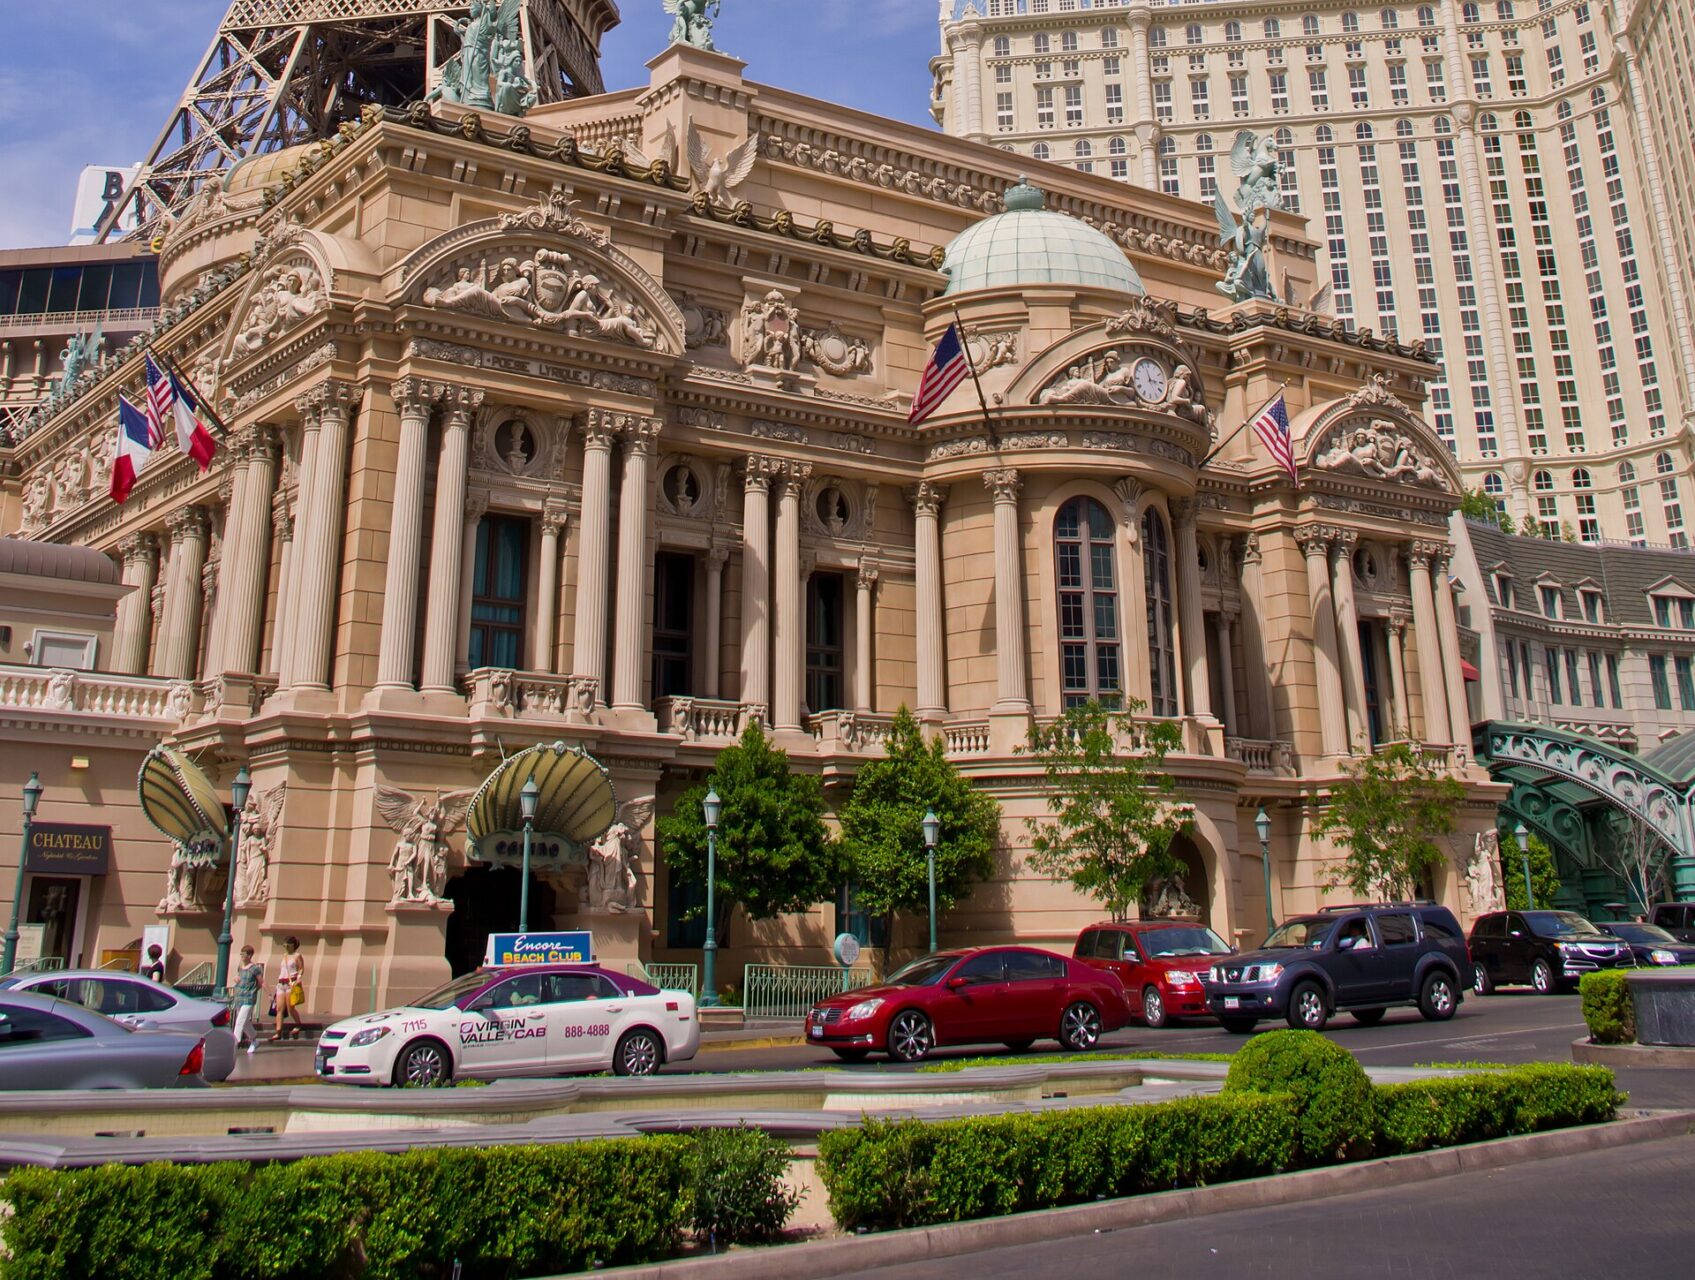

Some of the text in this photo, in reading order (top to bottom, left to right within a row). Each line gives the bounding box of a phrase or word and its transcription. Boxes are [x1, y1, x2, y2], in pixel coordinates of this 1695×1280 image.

[33, 832, 103, 850] CHATEAU
[495, 840, 560, 857] CAINO
[513, 935, 574, 952] Encore
[502, 951, 582, 964] BEACH CLUB
[401, 1019, 428, 1033] 7115
[476, 1019, 526, 1033] VIRGIN
[564, 1024, 610, 1038] 888-4888
